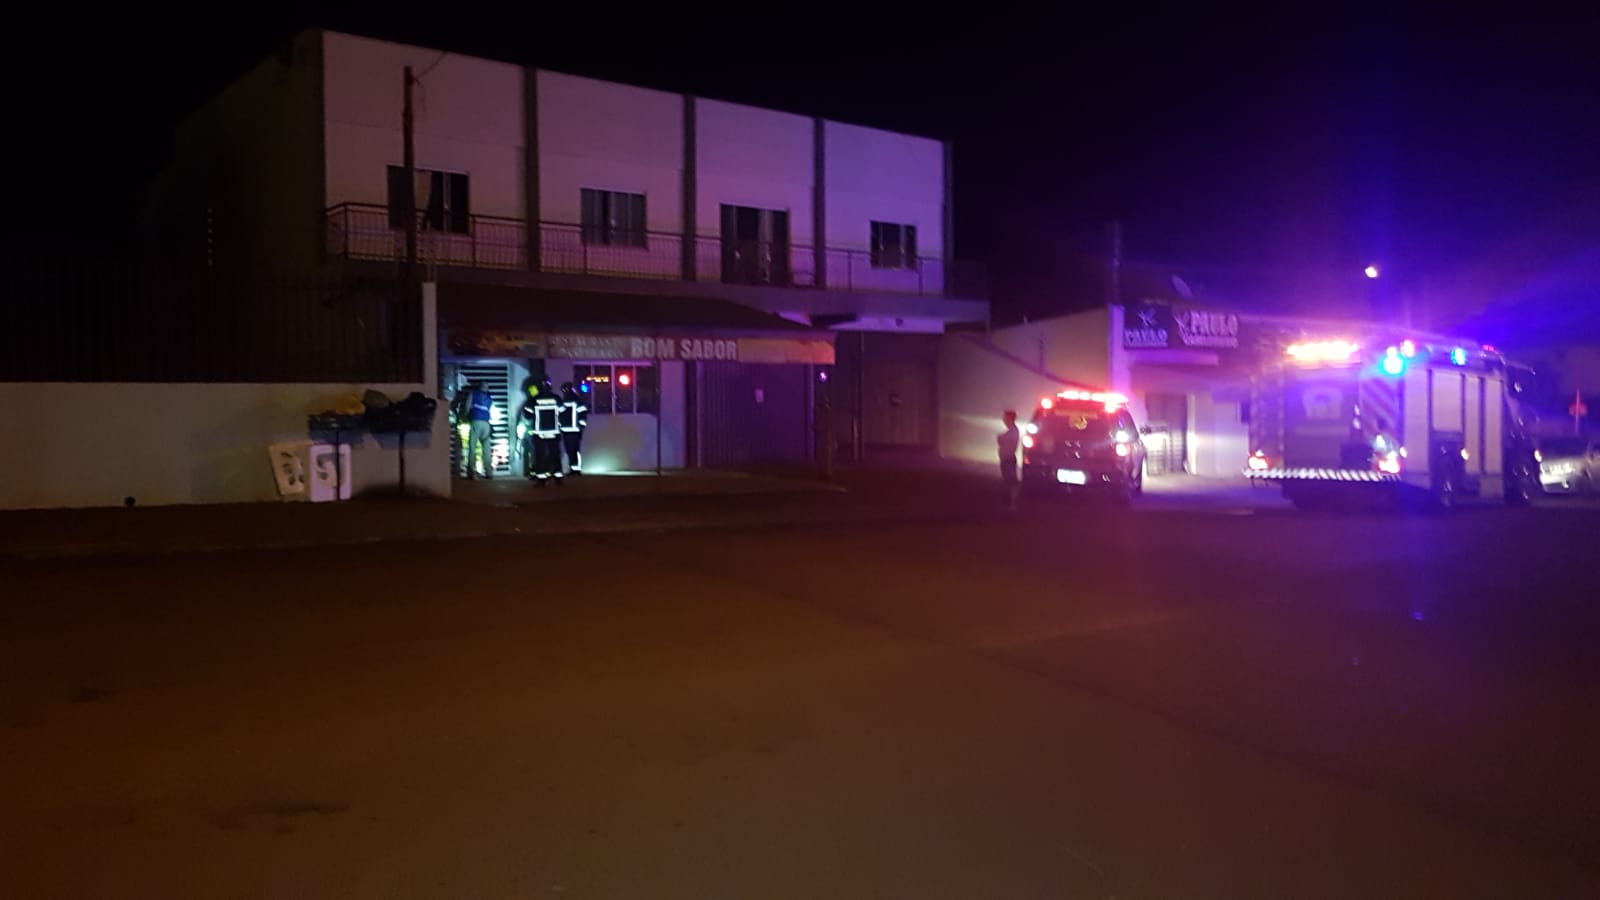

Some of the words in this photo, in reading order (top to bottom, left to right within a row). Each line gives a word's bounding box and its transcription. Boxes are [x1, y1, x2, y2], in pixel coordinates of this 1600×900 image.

[1190, 311, 1239, 336] PAULO
[631, 336, 675, 359] BOM
[681, 338, 737, 361] SABOR
